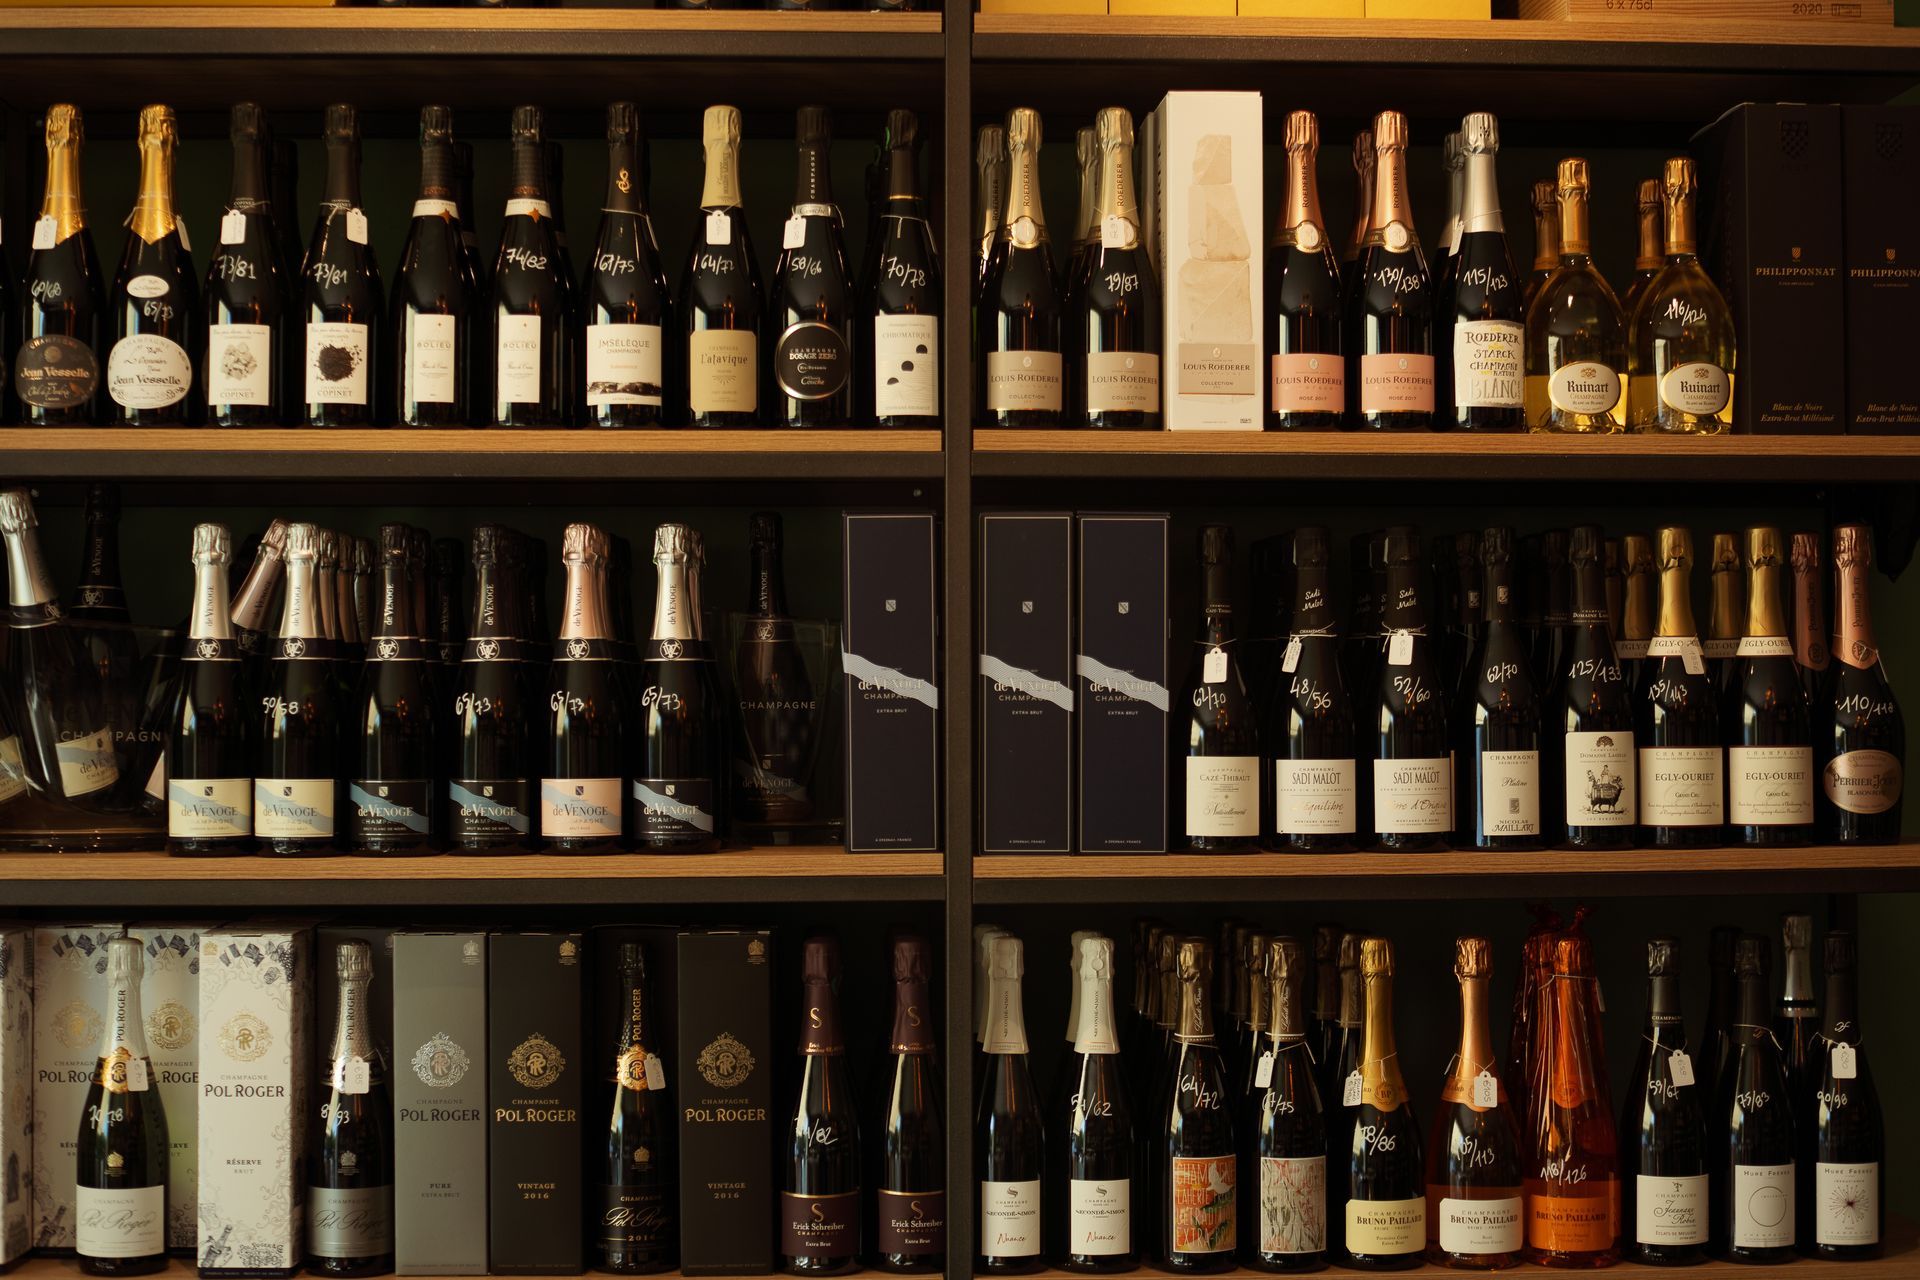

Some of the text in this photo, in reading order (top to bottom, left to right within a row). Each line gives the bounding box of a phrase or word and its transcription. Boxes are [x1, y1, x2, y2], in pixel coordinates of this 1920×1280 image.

[1606, 0, 1614, 9] 6
[1793, 4, 1823, 14] 2020
[1022, 163, 1030, 207] ROEDERER
[1116, 163, 1124, 207] ROEDERER
[1302, 164, 1310, 208] ROEDERER
[1393, 165, 1401, 209] ROEDERER
[506, 249, 548, 271] 74/82
[791, 256, 823, 279] 58/66
[887, 256, 927, 288] 70/78
[1755, 266, 1837, 277] PHILIPPONNAT
[313, 262, 349, 289] 73/81
[1376, 267, 1421, 294] 130/138
[1463, 266, 1509, 296] 115/123
[1105, 271, 1140, 297] 79/87
[1465, 330, 1520, 345] ROEDERER
[1474, 348, 1515, 360] STARCK
[44, 364, 91, 379] Vesselle
[1183, 362, 1251, 371] LOUIS ROEDERER
[114, 373, 181, 386] Jean Vesselle
[991, 373, 1060, 384] LOUIS ROEDERER
[1092, 375, 1158, 385] LOUIS ROEDERER
[1275, 375, 1343, 386] LOUIS ROEDERER
[1365, 375, 1433, 385] LOUIS ROEDERER
[317, 389, 353, 398] COPINET
[1567, 380, 1609, 394] Ruinart
[1680, 381, 1721, 394] Ruinart
[1772, 403, 1824, 411] Blanc de Noirs
[1867, 403, 1919, 412] Blanc de Noirs
[1761, 414, 1836, 423] Extra-Brut Millésimé
[1304, 588, 1321, 601] Sadi
[1398, 587, 1416, 600] Sadi
[385, 582, 395, 626] de VENOGE
[484, 583, 494, 626] de VENOGE
[574, 585, 584, 627] de VENOGE
[668, 583, 678, 625] de VENOGE
[1486, 662, 1518, 683] 62/70
[1289, 676, 1332, 710] 48/56
[1393, 676, 1431, 703] 52/60
[550, 691, 584, 716] 65/73
[640, 686, 681, 711] 65/73
[740, 700, 817, 710] CHAMPAGNE
[1192, 686, 1227, 710] 62/70
[1292, 771, 1341, 785] SADI MALOT
[1392, 771, 1441, 784] SADI MALOT
[1655, 772, 1715, 782] EGLY-OURIET
[1745, 772, 1806, 781] EGLY-OURIET
[181, 801, 238, 817] de VENOGE
[262, 802, 318, 817] de VENOGE
[357, 803, 414, 817] de VENOGE
[460, 803, 517, 817] de VENOGE
[552, 802, 609, 817] de VENOGE
[643, 803, 699, 817] de VENOGE
[1491, 823, 1535, 833] MAILLART
[116, 989, 127, 1042] POL ROGER
[345, 988, 355, 1041] POL ROGER
[632, 988, 642, 1041] POL ROGER
[810, 1007, 823, 1029] S
[907, 1006, 921, 1027] S
[204, 1084, 285, 1097] POL ROGER
[1180, 1074, 1220, 1110] 64/72
[400, 1108, 480, 1122] POL ROGER
[495, 1107, 577, 1122] POL ROGER
[685, 1107, 766, 1122] POL ROGER
[226, 1158, 263, 1166] RÉSERVE
[811, 1202, 824, 1222] S
[910, 1200, 924, 1220] S
[986, 1208, 1036, 1216] SECONDÉ-SIMON
[1075, 1208, 1126, 1216] SECONDÉ-SIMON
[1367, 1208, 1416, 1216] CHAMPAGNE
[1536, 1211, 1607, 1222] BRUNO PAILLARD
[313, 1209, 338, 1230] Pol
[792, 1221, 845, 1231] Erick Schreiber
[890, 1219, 943, 1229] Erick Schreiber
[1356, 1214, 1423, 1225] BRUNO PAILLARD
[1450, 1214, 1518, 1225] BRUNO PAILLARD
